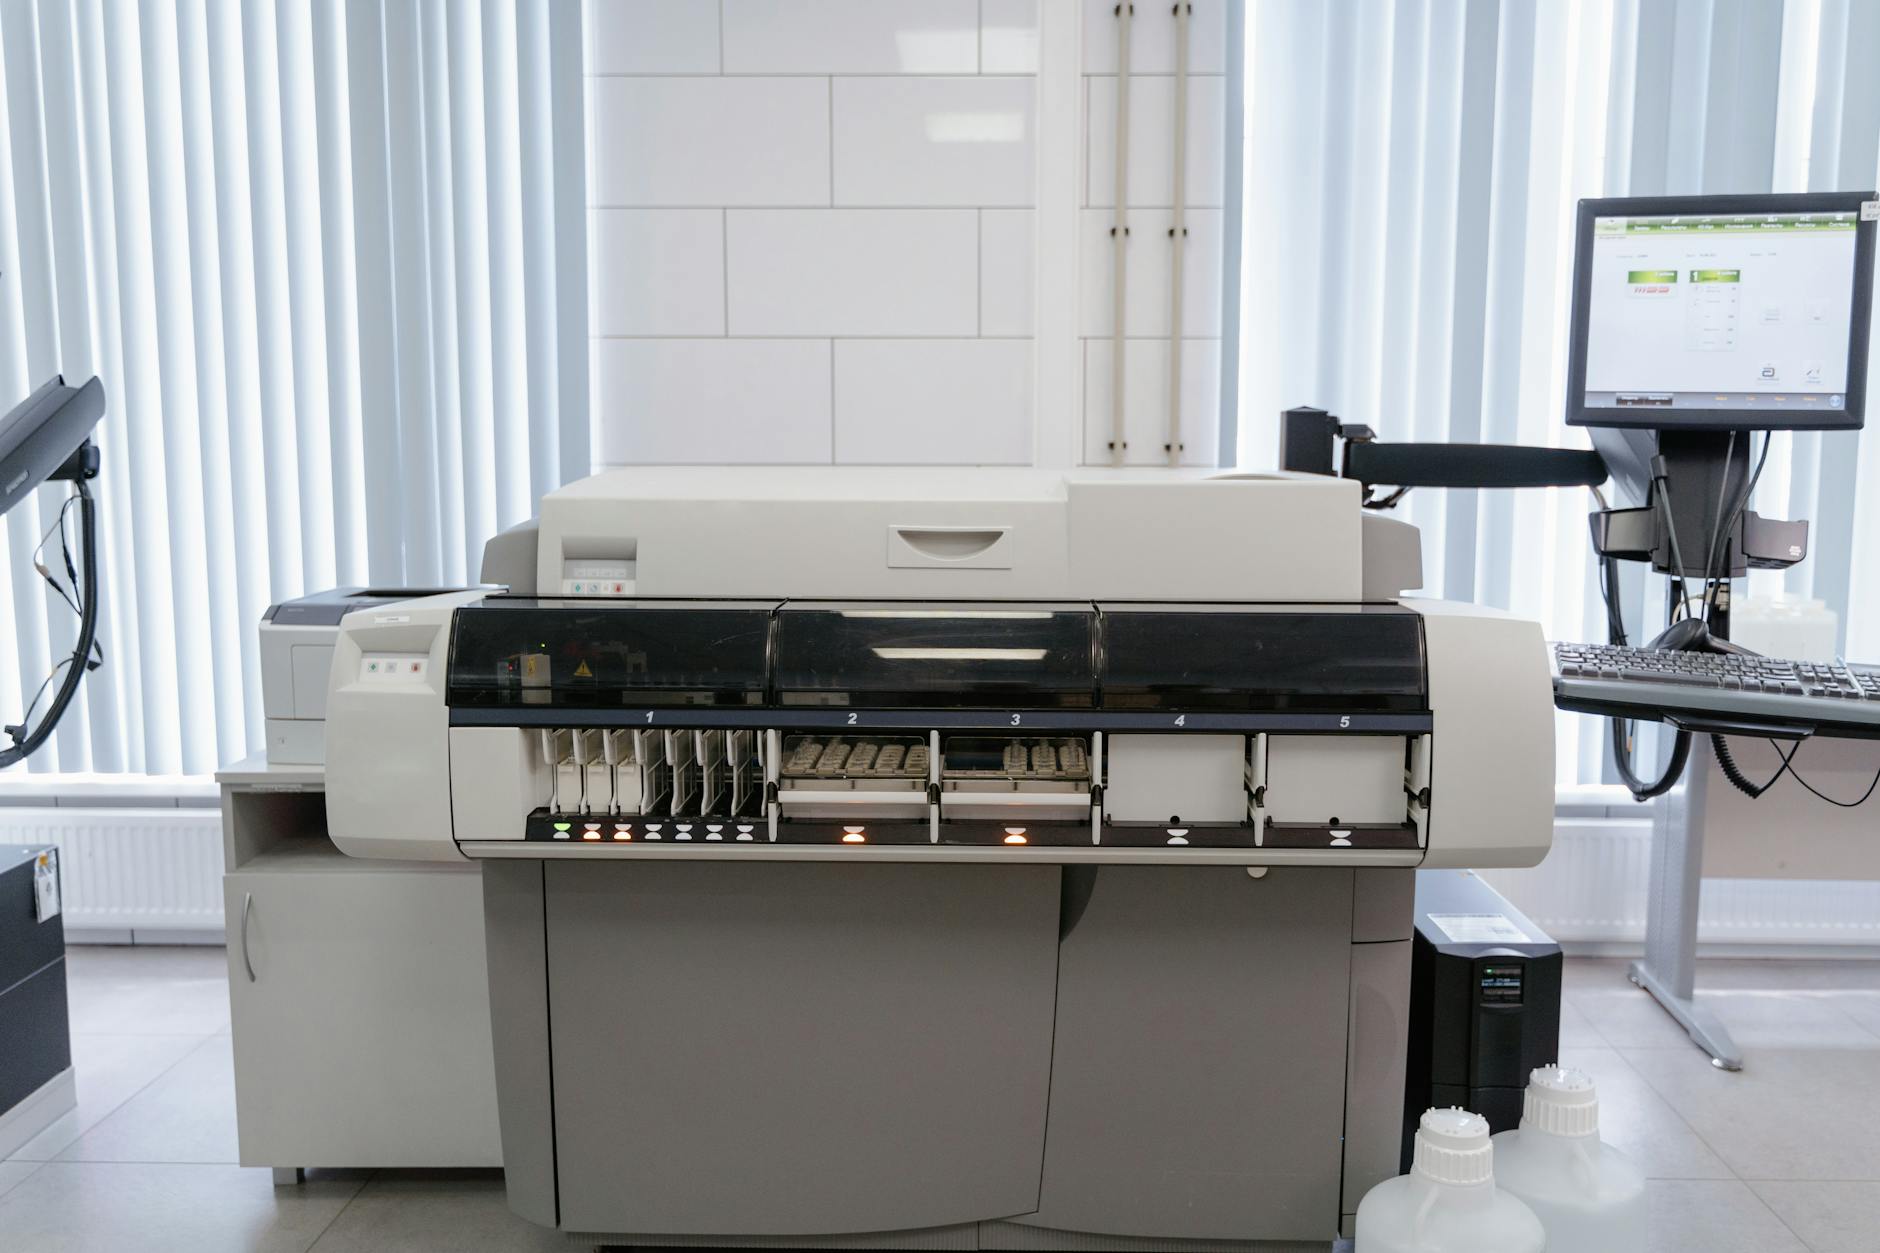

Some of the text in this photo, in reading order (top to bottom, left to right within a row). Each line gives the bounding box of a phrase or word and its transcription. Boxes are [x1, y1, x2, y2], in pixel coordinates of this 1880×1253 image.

[646, 711, 654, 723] 1
[847, 713, 858, 725] 2
[1010, 713, 1021, 725] 3
[1174, 715, 1185, 727] 4
[1339, 716, 1350, 728] 5
